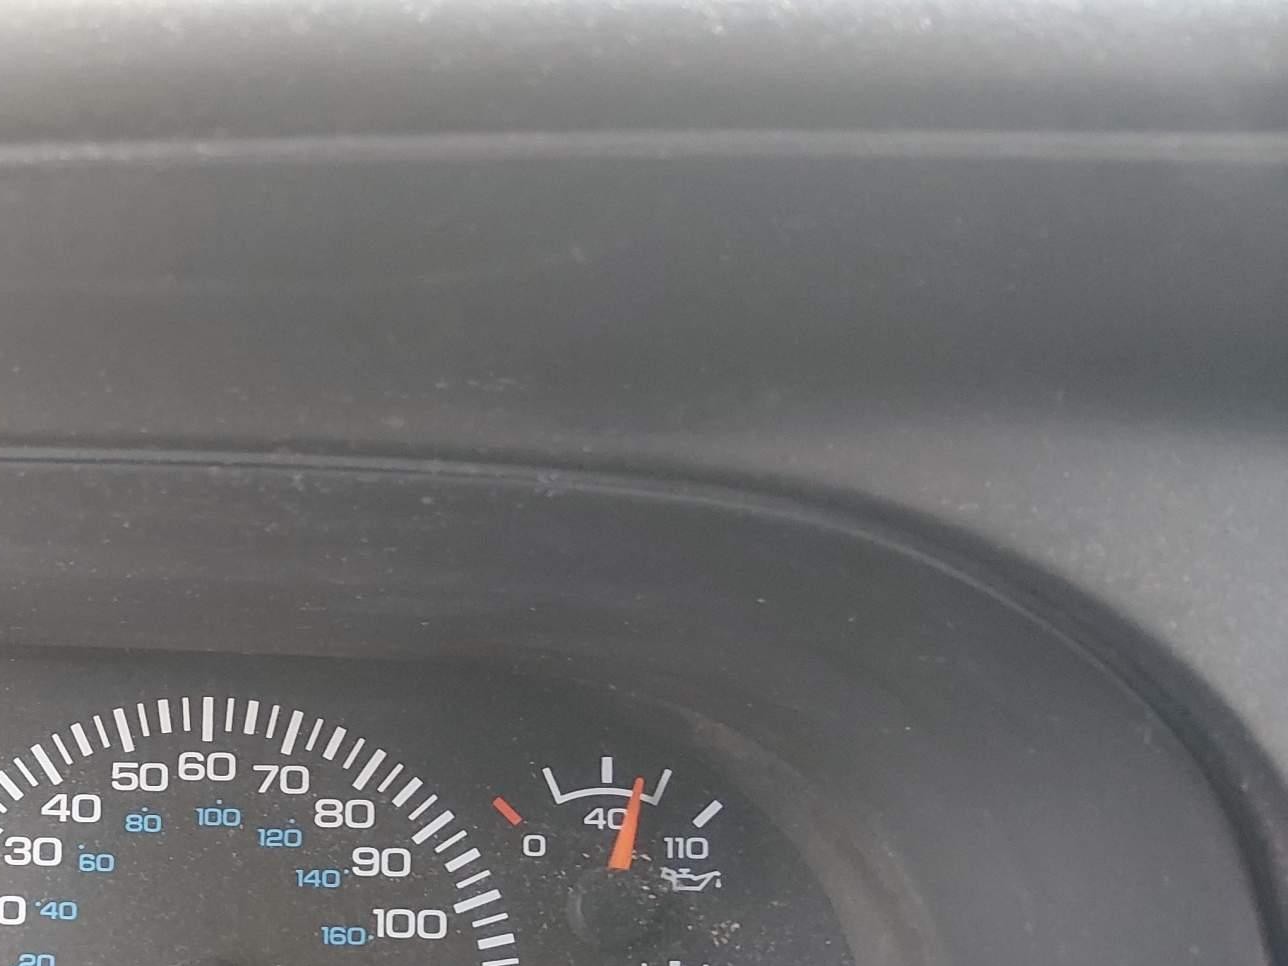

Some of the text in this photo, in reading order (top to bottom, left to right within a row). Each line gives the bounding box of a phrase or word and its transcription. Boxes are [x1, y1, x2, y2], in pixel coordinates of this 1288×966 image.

[111, 762, 169, 792] 50
[178, 751, 236, 781] 60
[252, 764, 310, 795] 70
[41, 793, 102, 823] 40
[196, 807, 241, 827] 100
[314, 798, 375, 829] 80
[125, 813, 162, 833] 80
[257, 828, 302, 847] 120
[523, 834, 546, 857] 0
[663, 837, 709, 860] 110
[4, 836, 63, 867] 30
[78, 853, 115, 872] 60
[352, 846, 411, 877] 90
[295, 869, 341, 888] 140
[39, 901, 78, 921] 40
[372, 908, 447, 939] 100
[321, 926, 366, 946] 160
